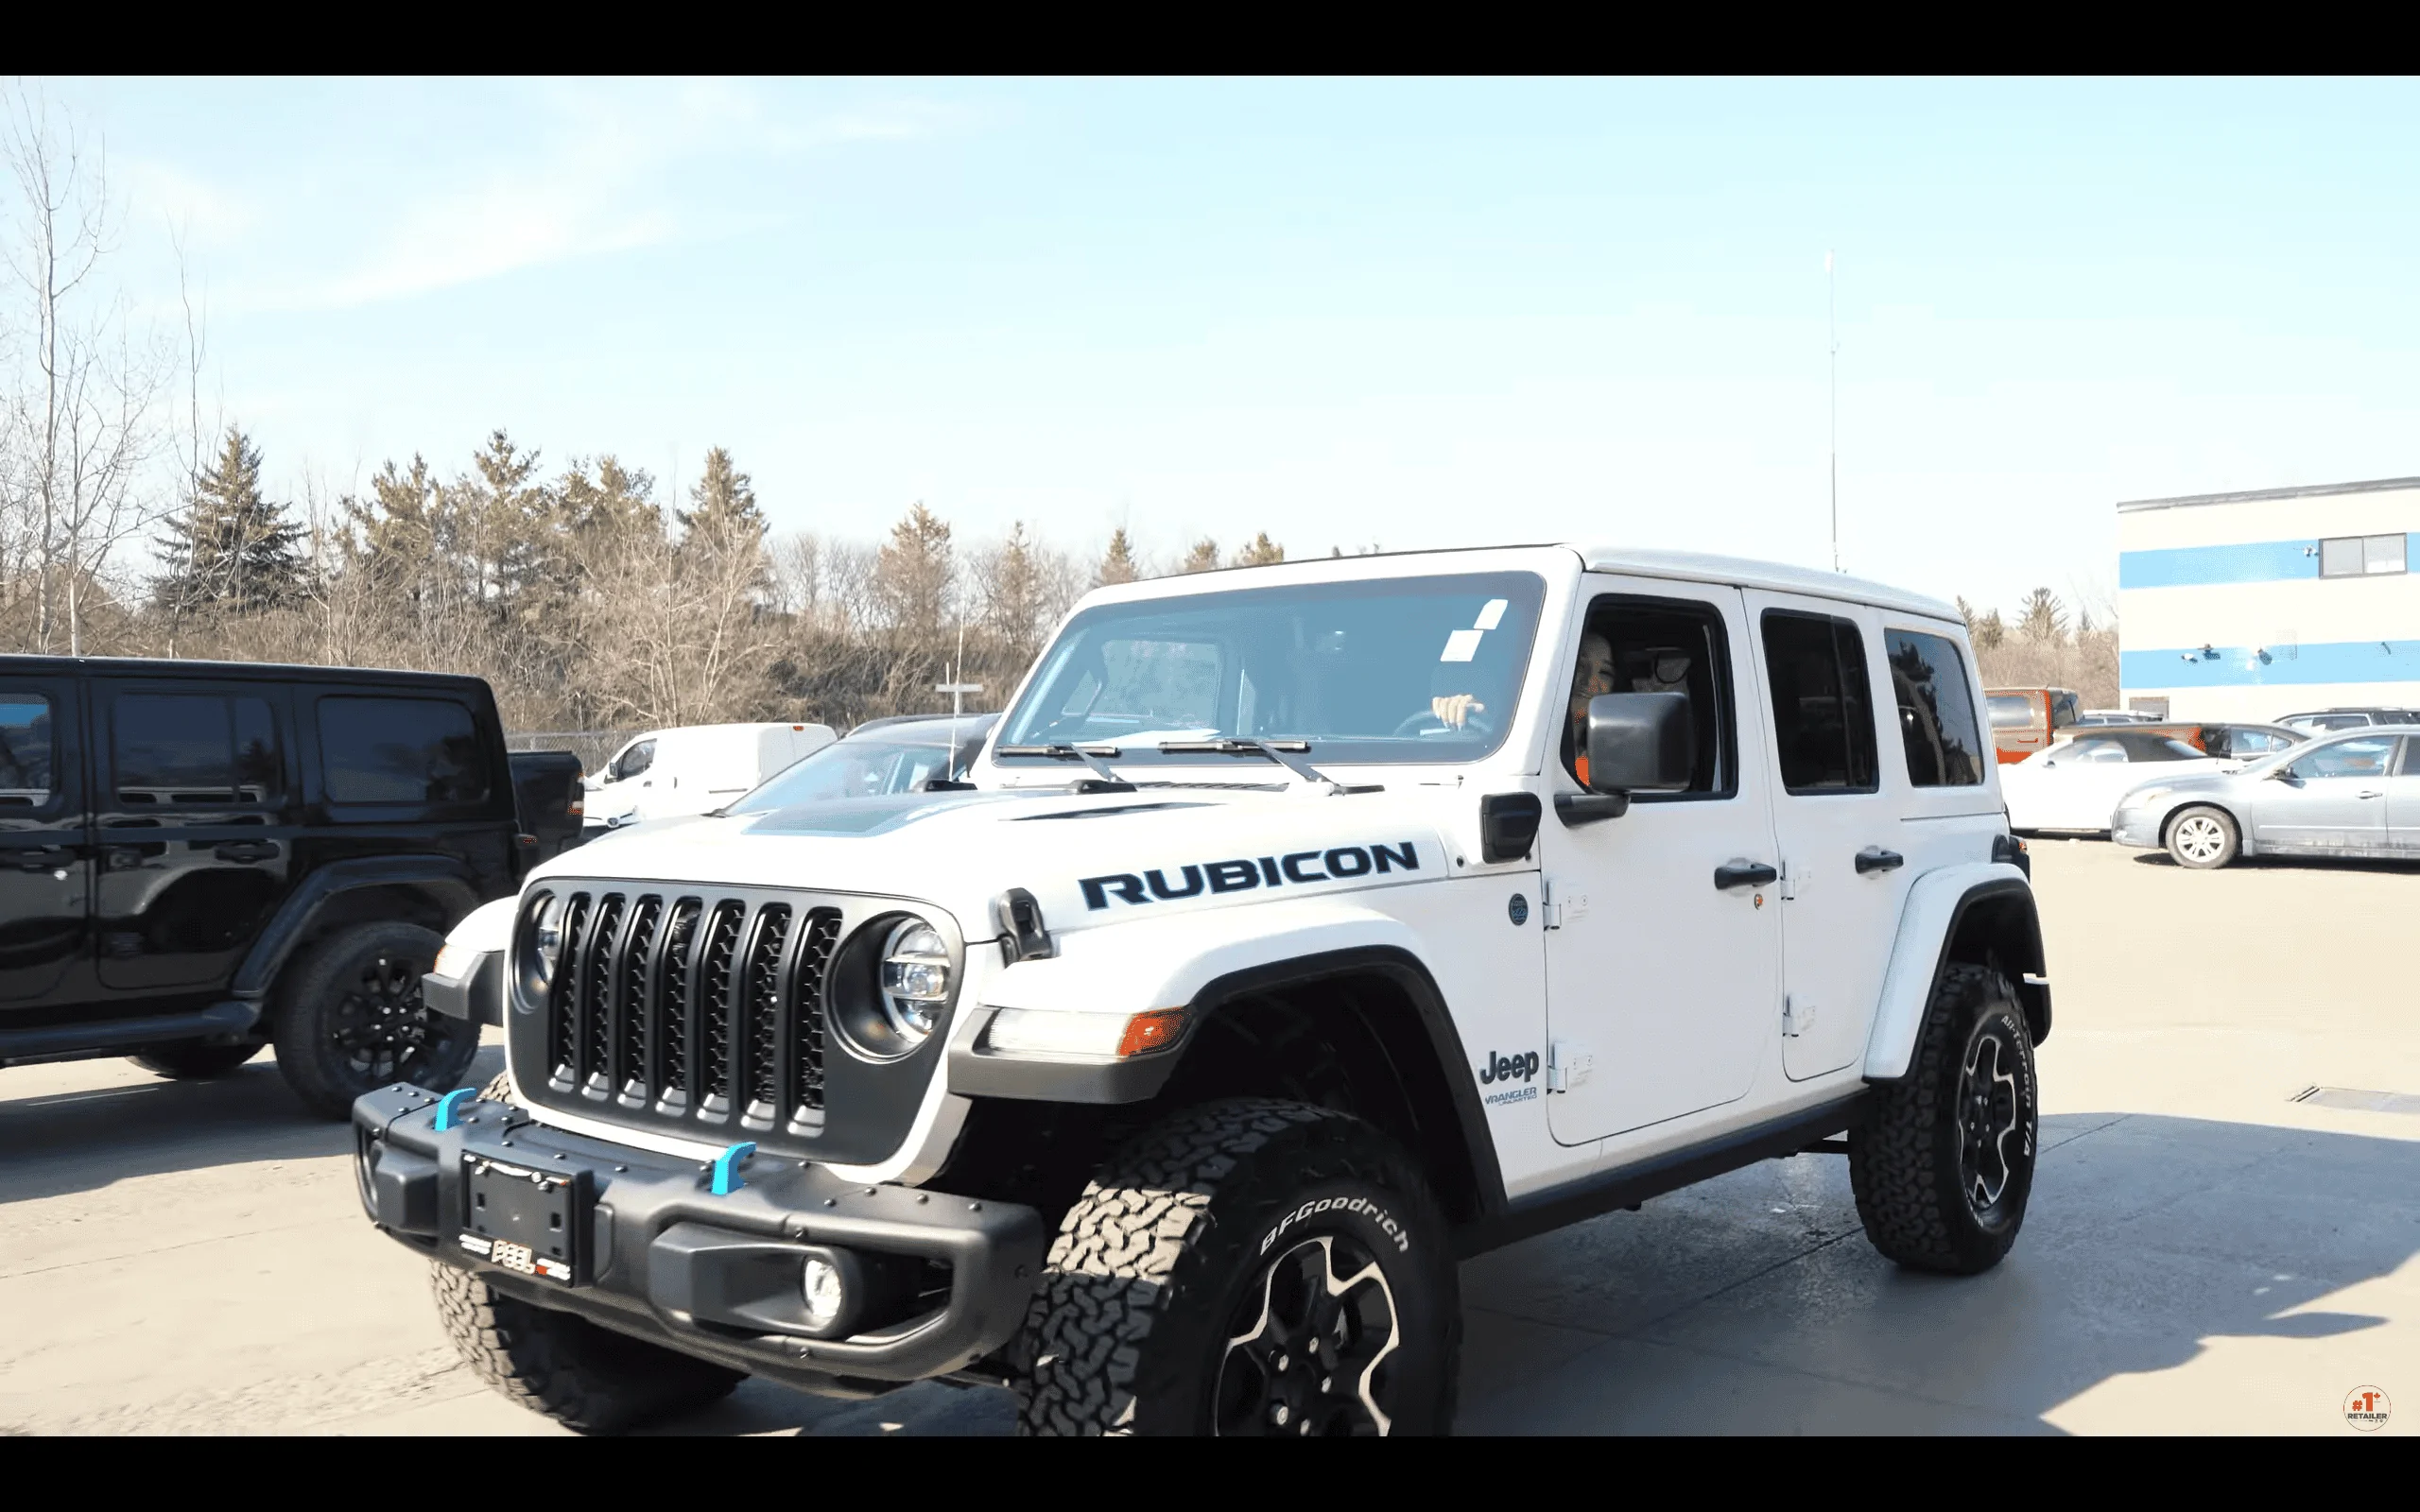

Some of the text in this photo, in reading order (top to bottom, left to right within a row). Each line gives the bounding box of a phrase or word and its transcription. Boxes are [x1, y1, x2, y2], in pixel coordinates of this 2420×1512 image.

[1078, 841, 1420, 911] RUBICON
[1479, 1050, 1540, 1085] Jeep
[1484, 1087, 1538, 1105] WRANGLER
[1260, 1196, 1409, 1256] BFGoodrich
